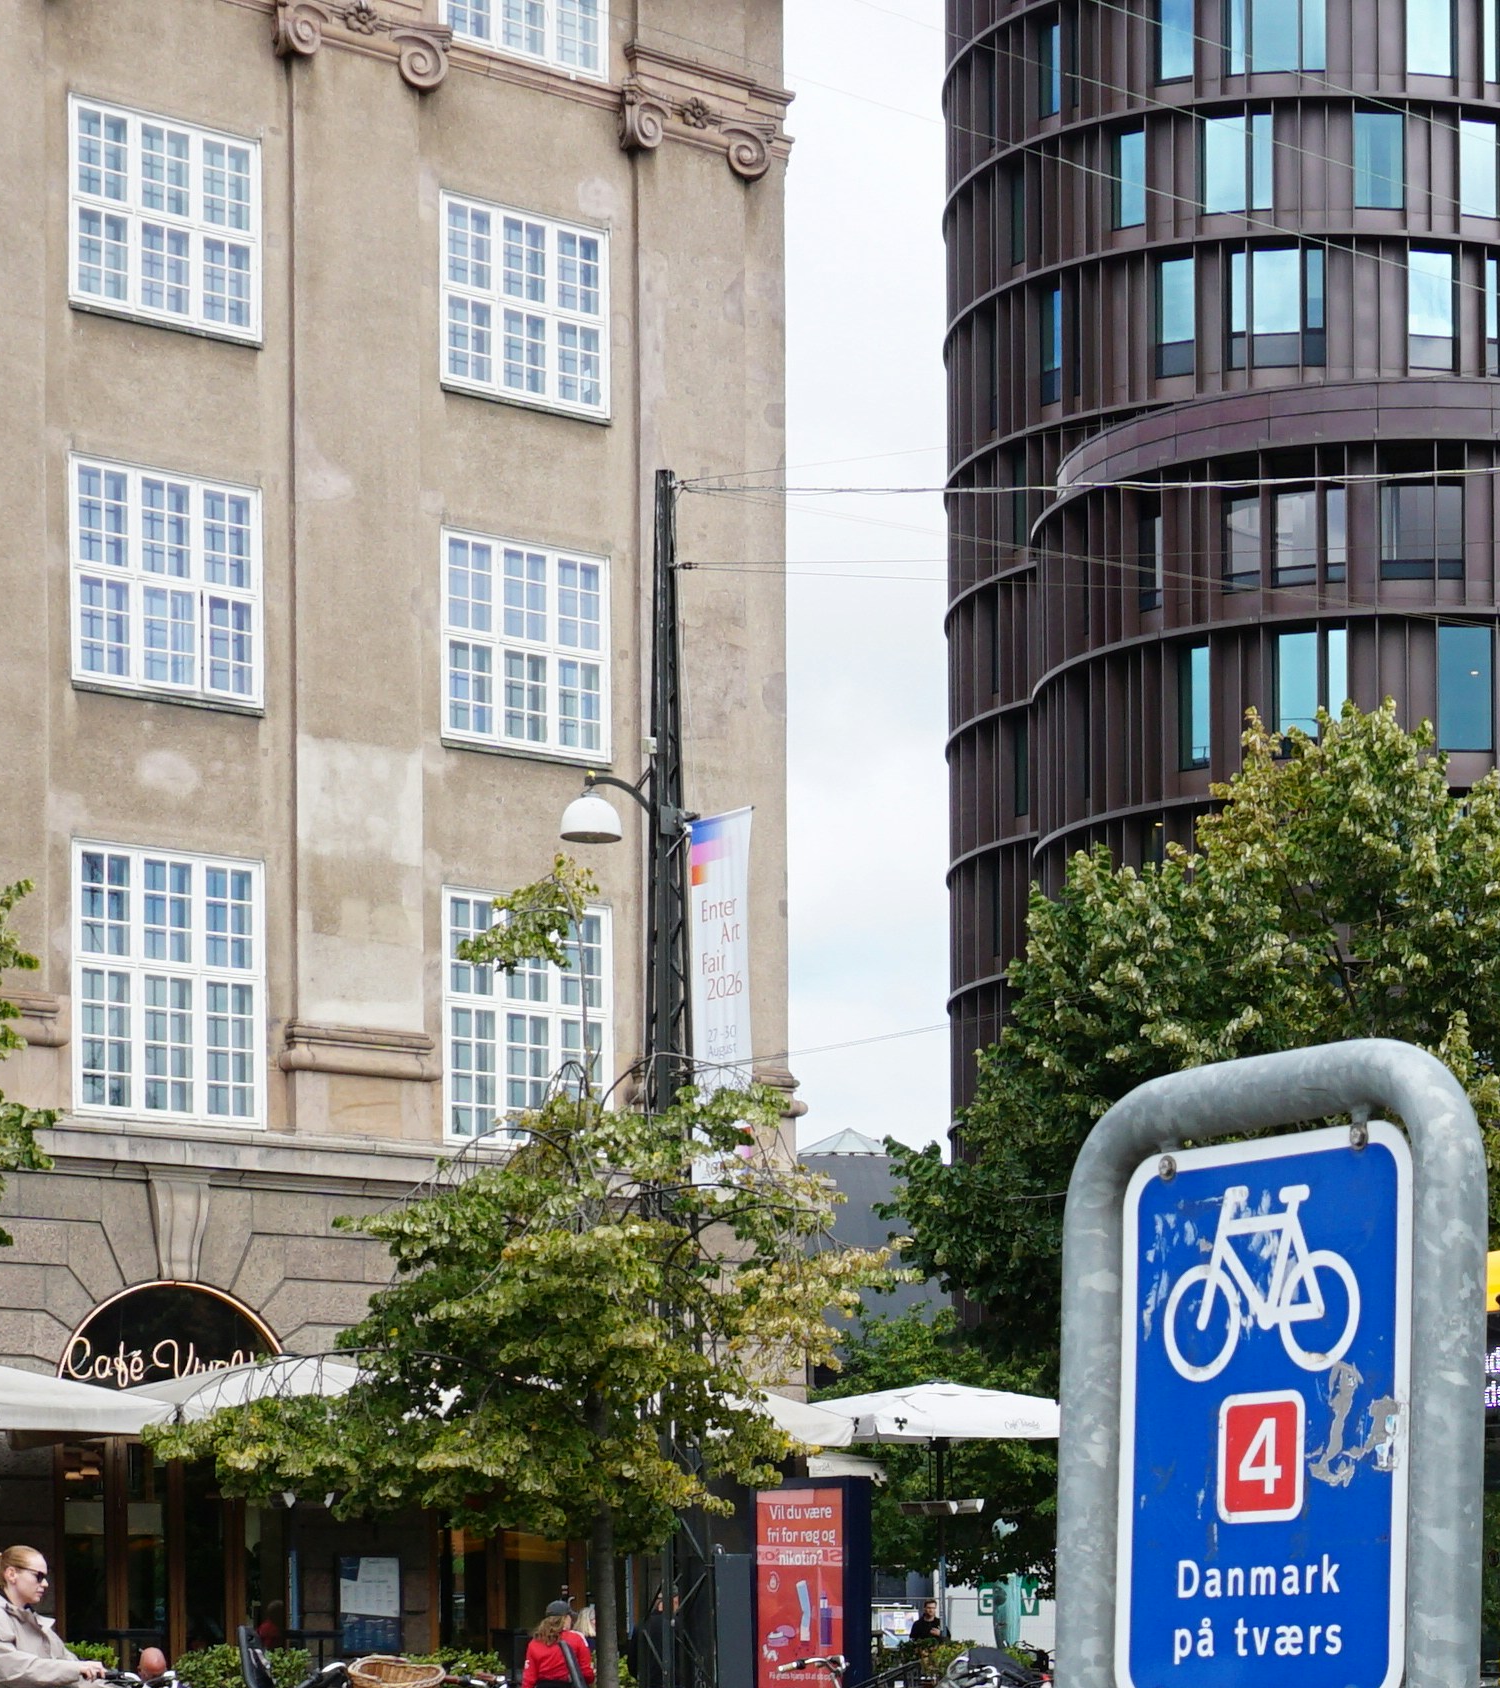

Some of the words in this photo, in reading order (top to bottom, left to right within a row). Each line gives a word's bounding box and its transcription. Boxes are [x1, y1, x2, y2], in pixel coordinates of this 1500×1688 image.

[701, 898, 737, 922] Enter
[720, 920, 740, 945] Art
[701, 951, 726, 976] Fair
[706, 974, 743, 1001] 2026
[707, 1029, 718, 1043] 27
[707, 1042, 737, 1061] August
[68, 1337, 144, 1387] Café
[1238, 1416, 1282, 1495] 4
[770, 1505, 785, 1519] Vil
[787, 1505, 801, 1519] du
[805, 1506, 832, 1519] være
[767, 1528, 779, 1542] fri
[781, 1528, 799, 1542] for
[800, 1529, 820, 1546] røg
[822, 1530, 836, 1545] og
[779, 1549, 823, 1566] nikotin?
[1176, 1553, 1340, 1599] Danmark
[980, 1594, 1038, 1612] GV
[1173, 1617, 1213, 1665] på
[1235, 1616, 1342, 1657] tværs
